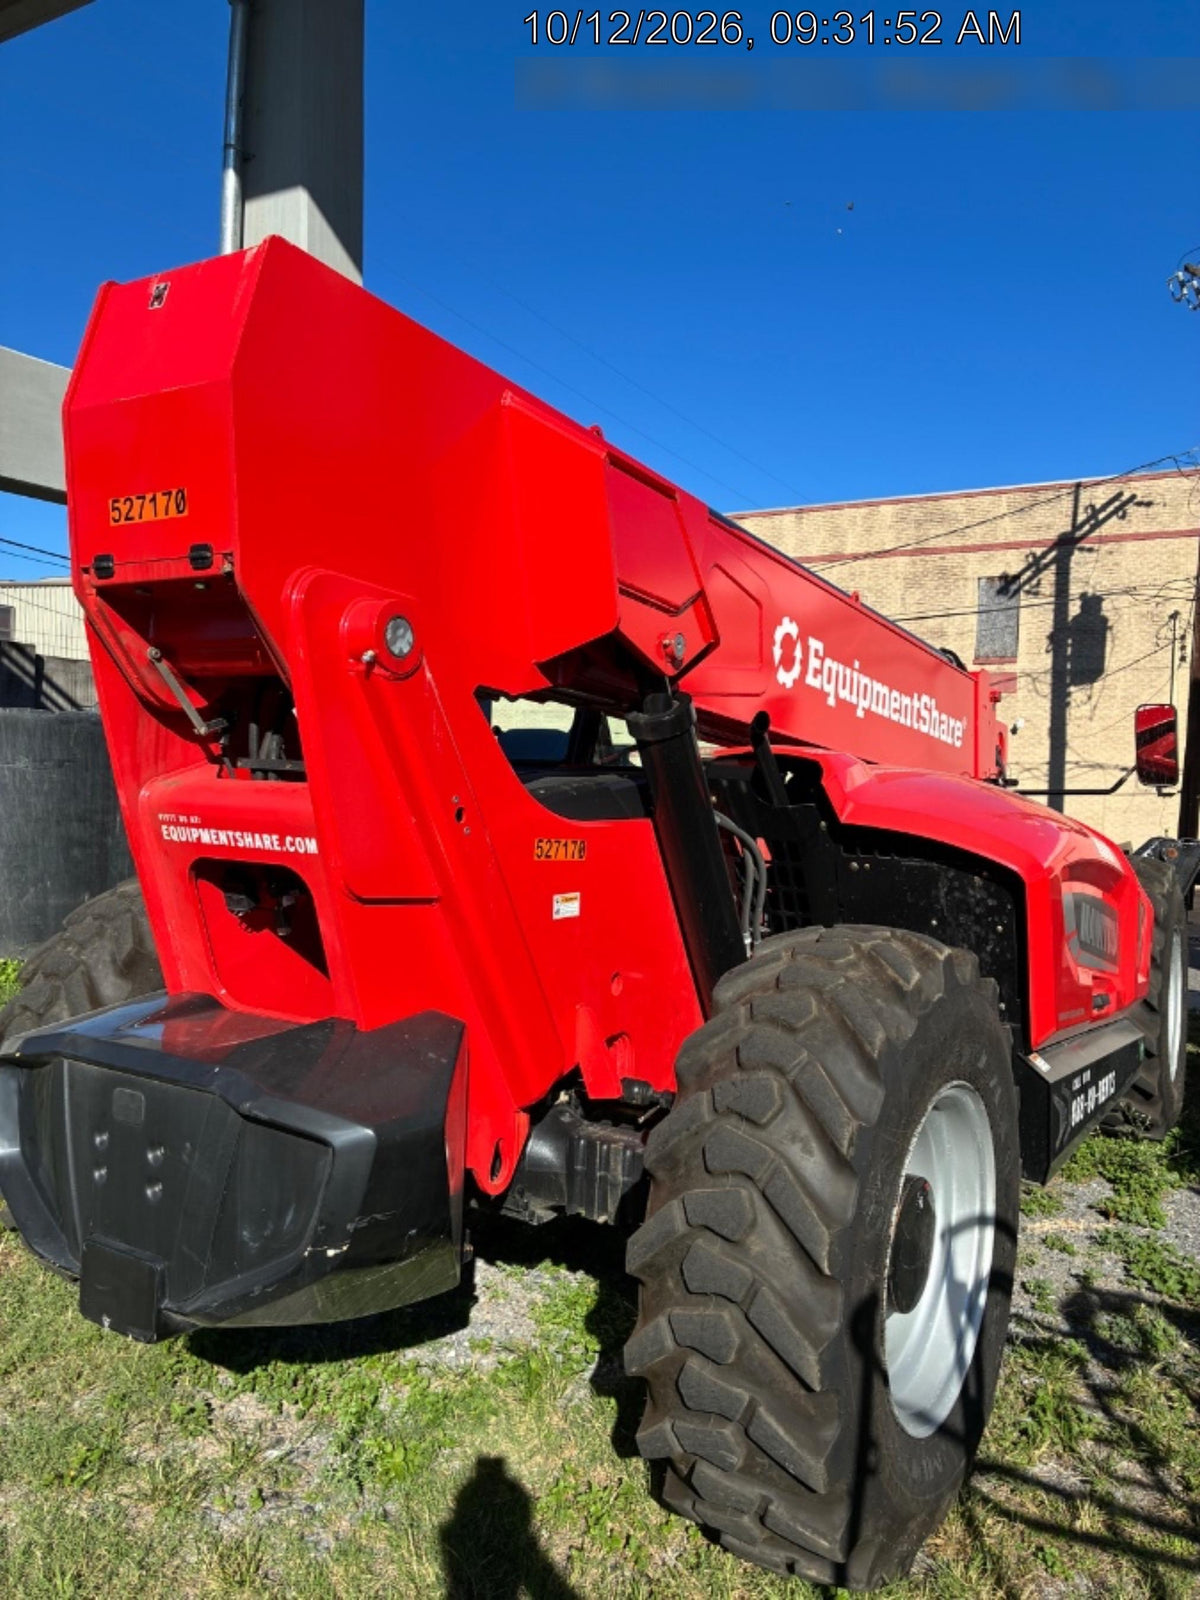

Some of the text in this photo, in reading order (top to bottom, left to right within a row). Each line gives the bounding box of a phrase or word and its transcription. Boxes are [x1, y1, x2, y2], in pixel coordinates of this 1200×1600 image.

[111, 488, 187, 523] 527170
[805, 636, 966, 748] EquipmentShare
[161, 825, 319, 854] EQUIPMENTSHARE.COM
[536, 839, 586, 859] 527170
